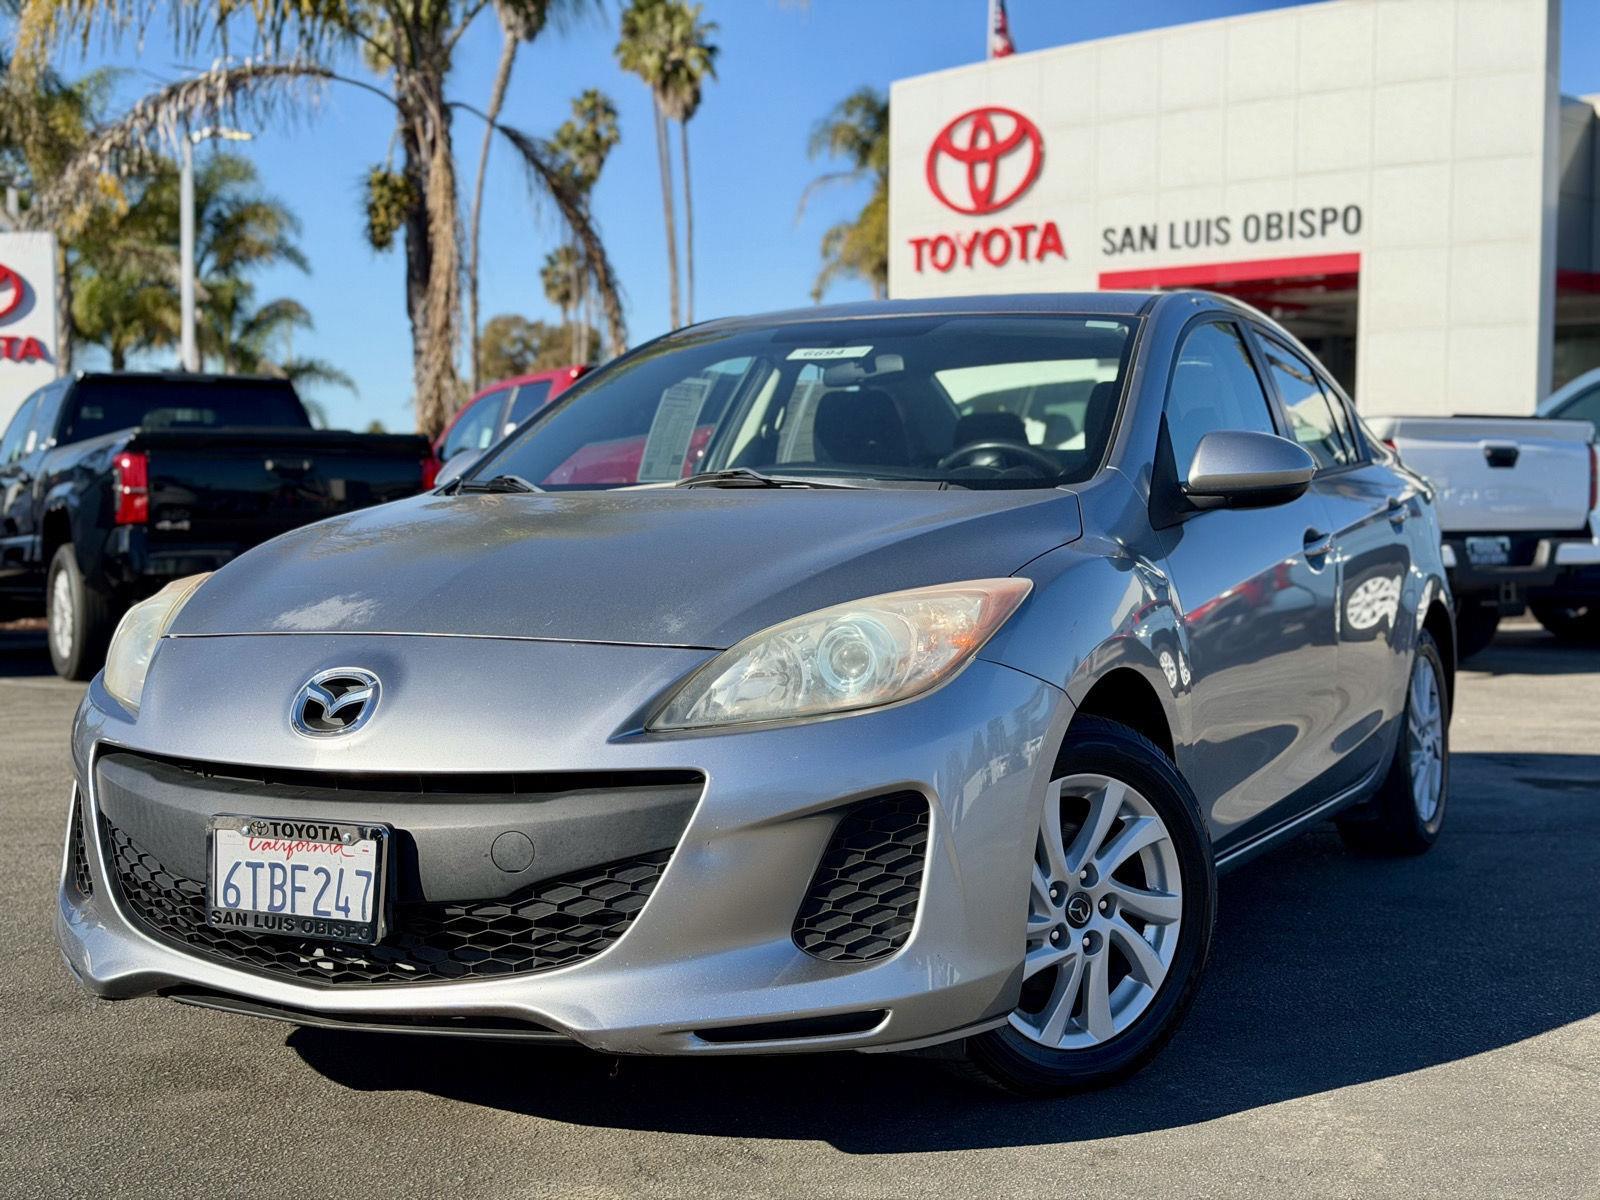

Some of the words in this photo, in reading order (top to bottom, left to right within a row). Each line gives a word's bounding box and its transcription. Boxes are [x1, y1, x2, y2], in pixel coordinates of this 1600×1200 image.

[908, 221, 1066, 273] TOYOTA
[1102, 224, 1158, 256] SAN
[1169, 217, 1231, 251] LUIS
[1242, 205, 1363, 246] OBISPO
[249, 837, 355, 860] California
[271, 823, 342, 842] TOYOTA
[223, 861, 373, 921] 6TBF247
[211, 911, 247, 927] SAN
[254, 914, 295, 932] LUIS
[301, 920, 371, 940] OBISPO
